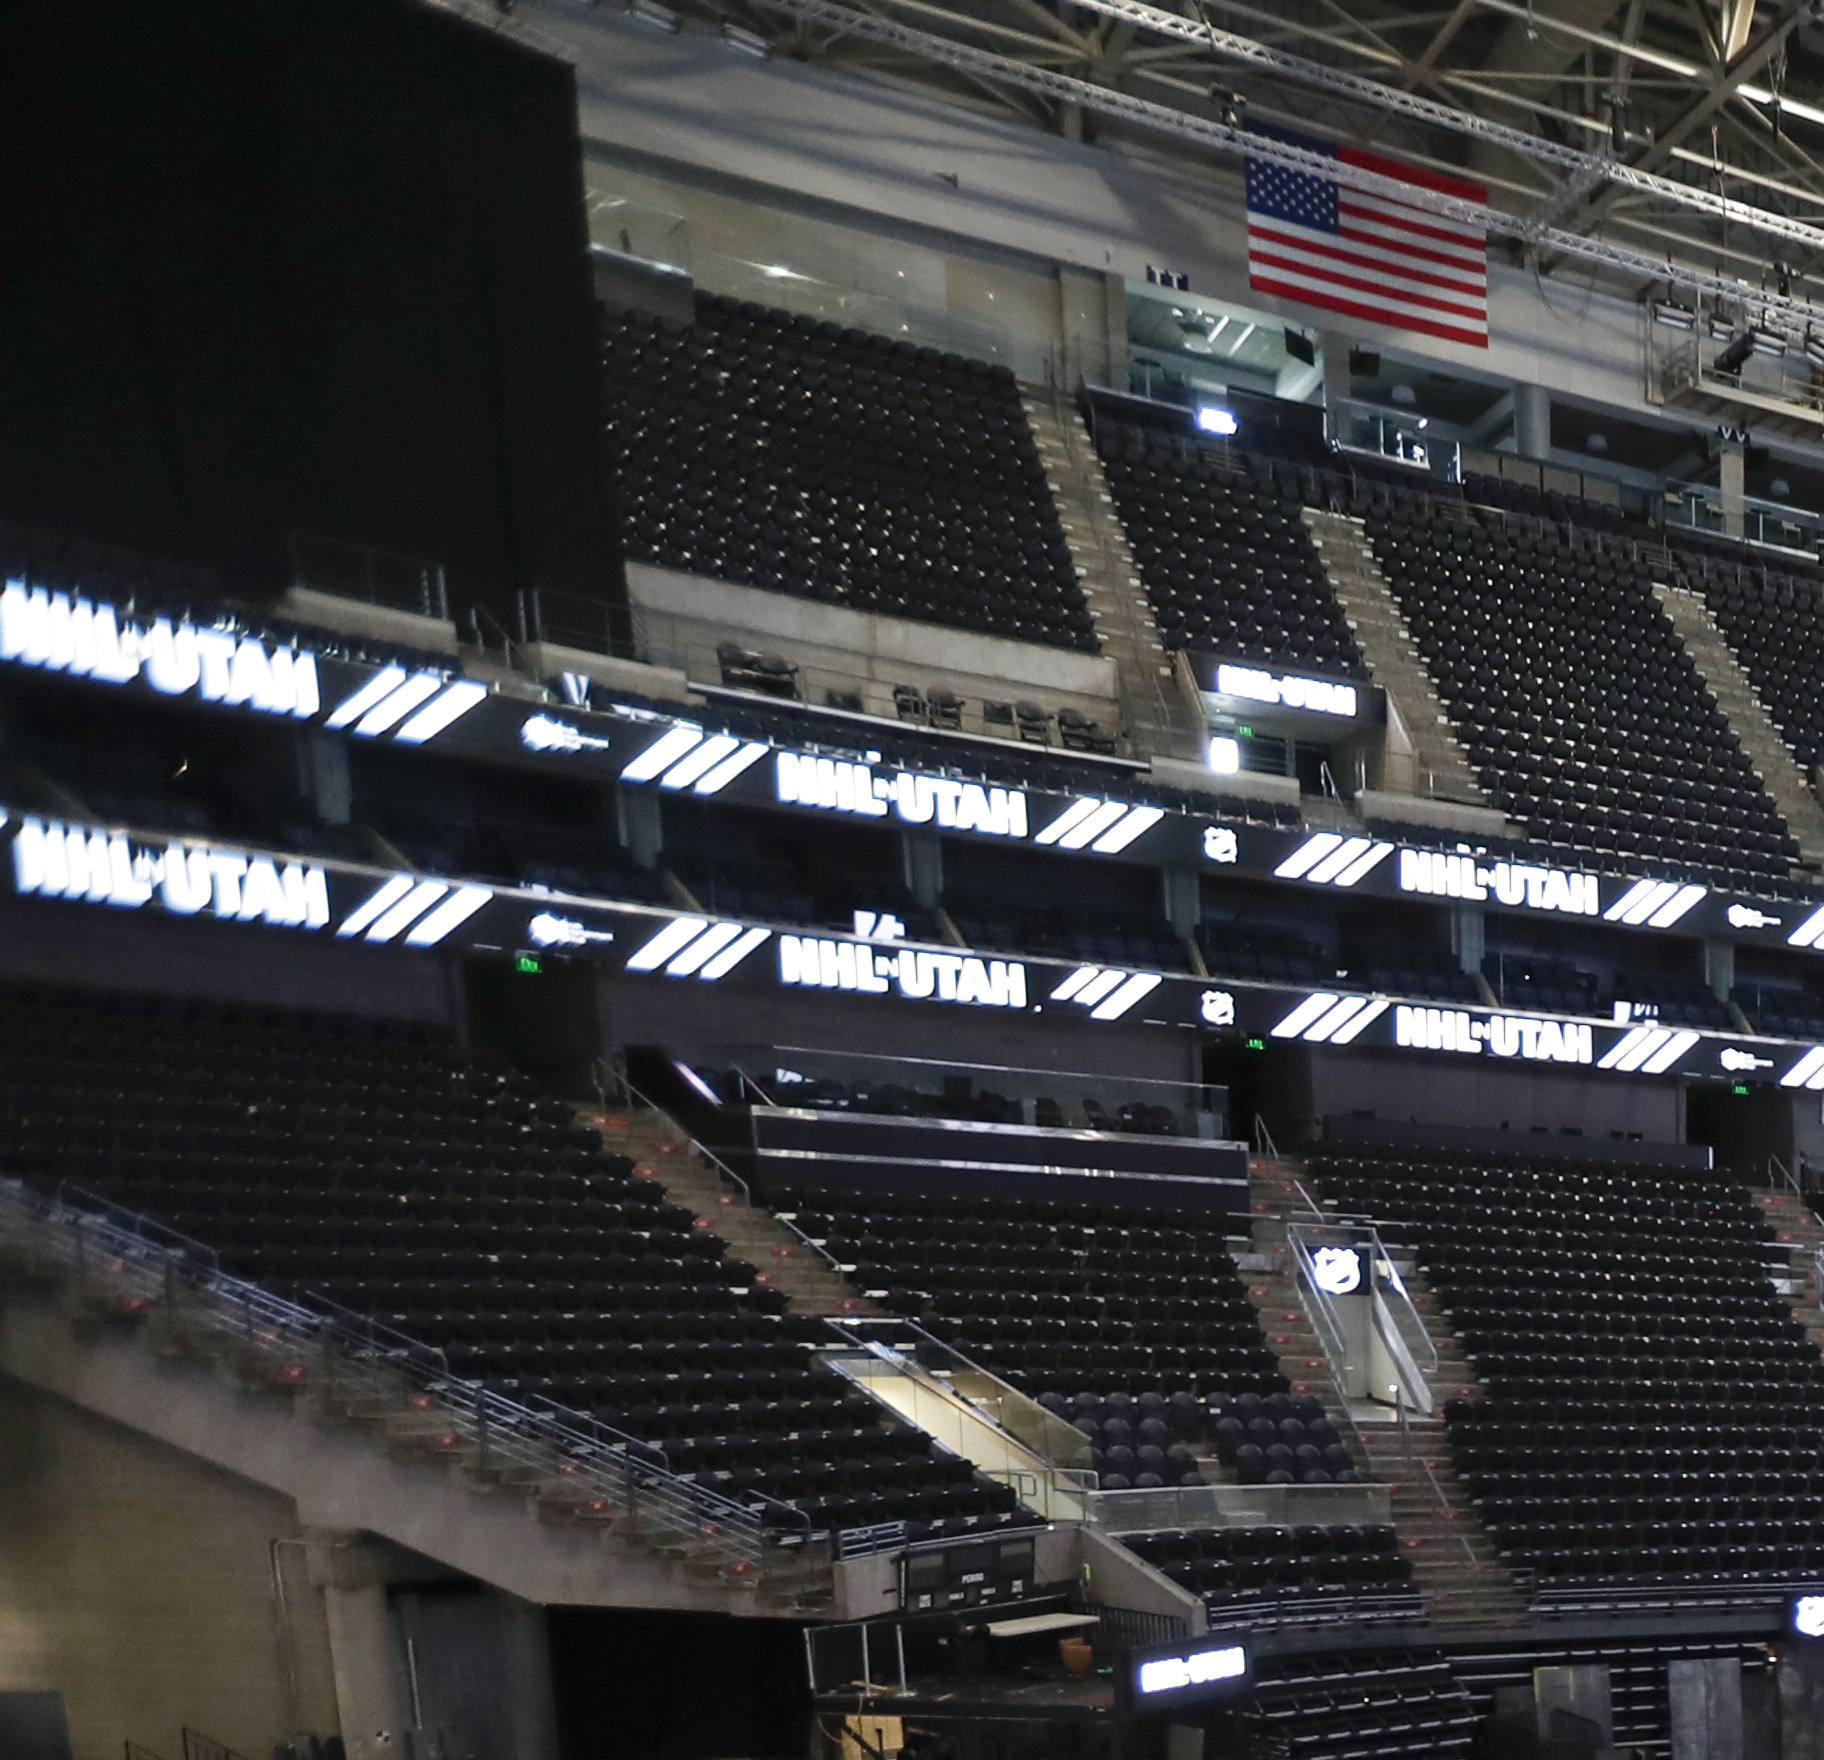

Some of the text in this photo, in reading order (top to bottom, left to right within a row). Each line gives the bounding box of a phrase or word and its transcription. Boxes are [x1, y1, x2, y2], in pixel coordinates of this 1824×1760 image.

[0, 578, 140, 685] NHL
[148, 615, 320, 720] UTAH
[777, 751, 888, 816] NHL
[897, 772, 1028, 837] UTAH
[14, 815, 152, 908] NHL
[162, 841, 330, 930] UTAH
[1400, 849, 1487, 900] NHL
[1495, 863, 1599, 916] UTAH
[780, 934, 889, 993] NHL
[899, 950, 1027, 1008] UTAH
[1396, 1005, 1482, 1053] NHL
[1490, 1016, 1592, 1064] UTAH
